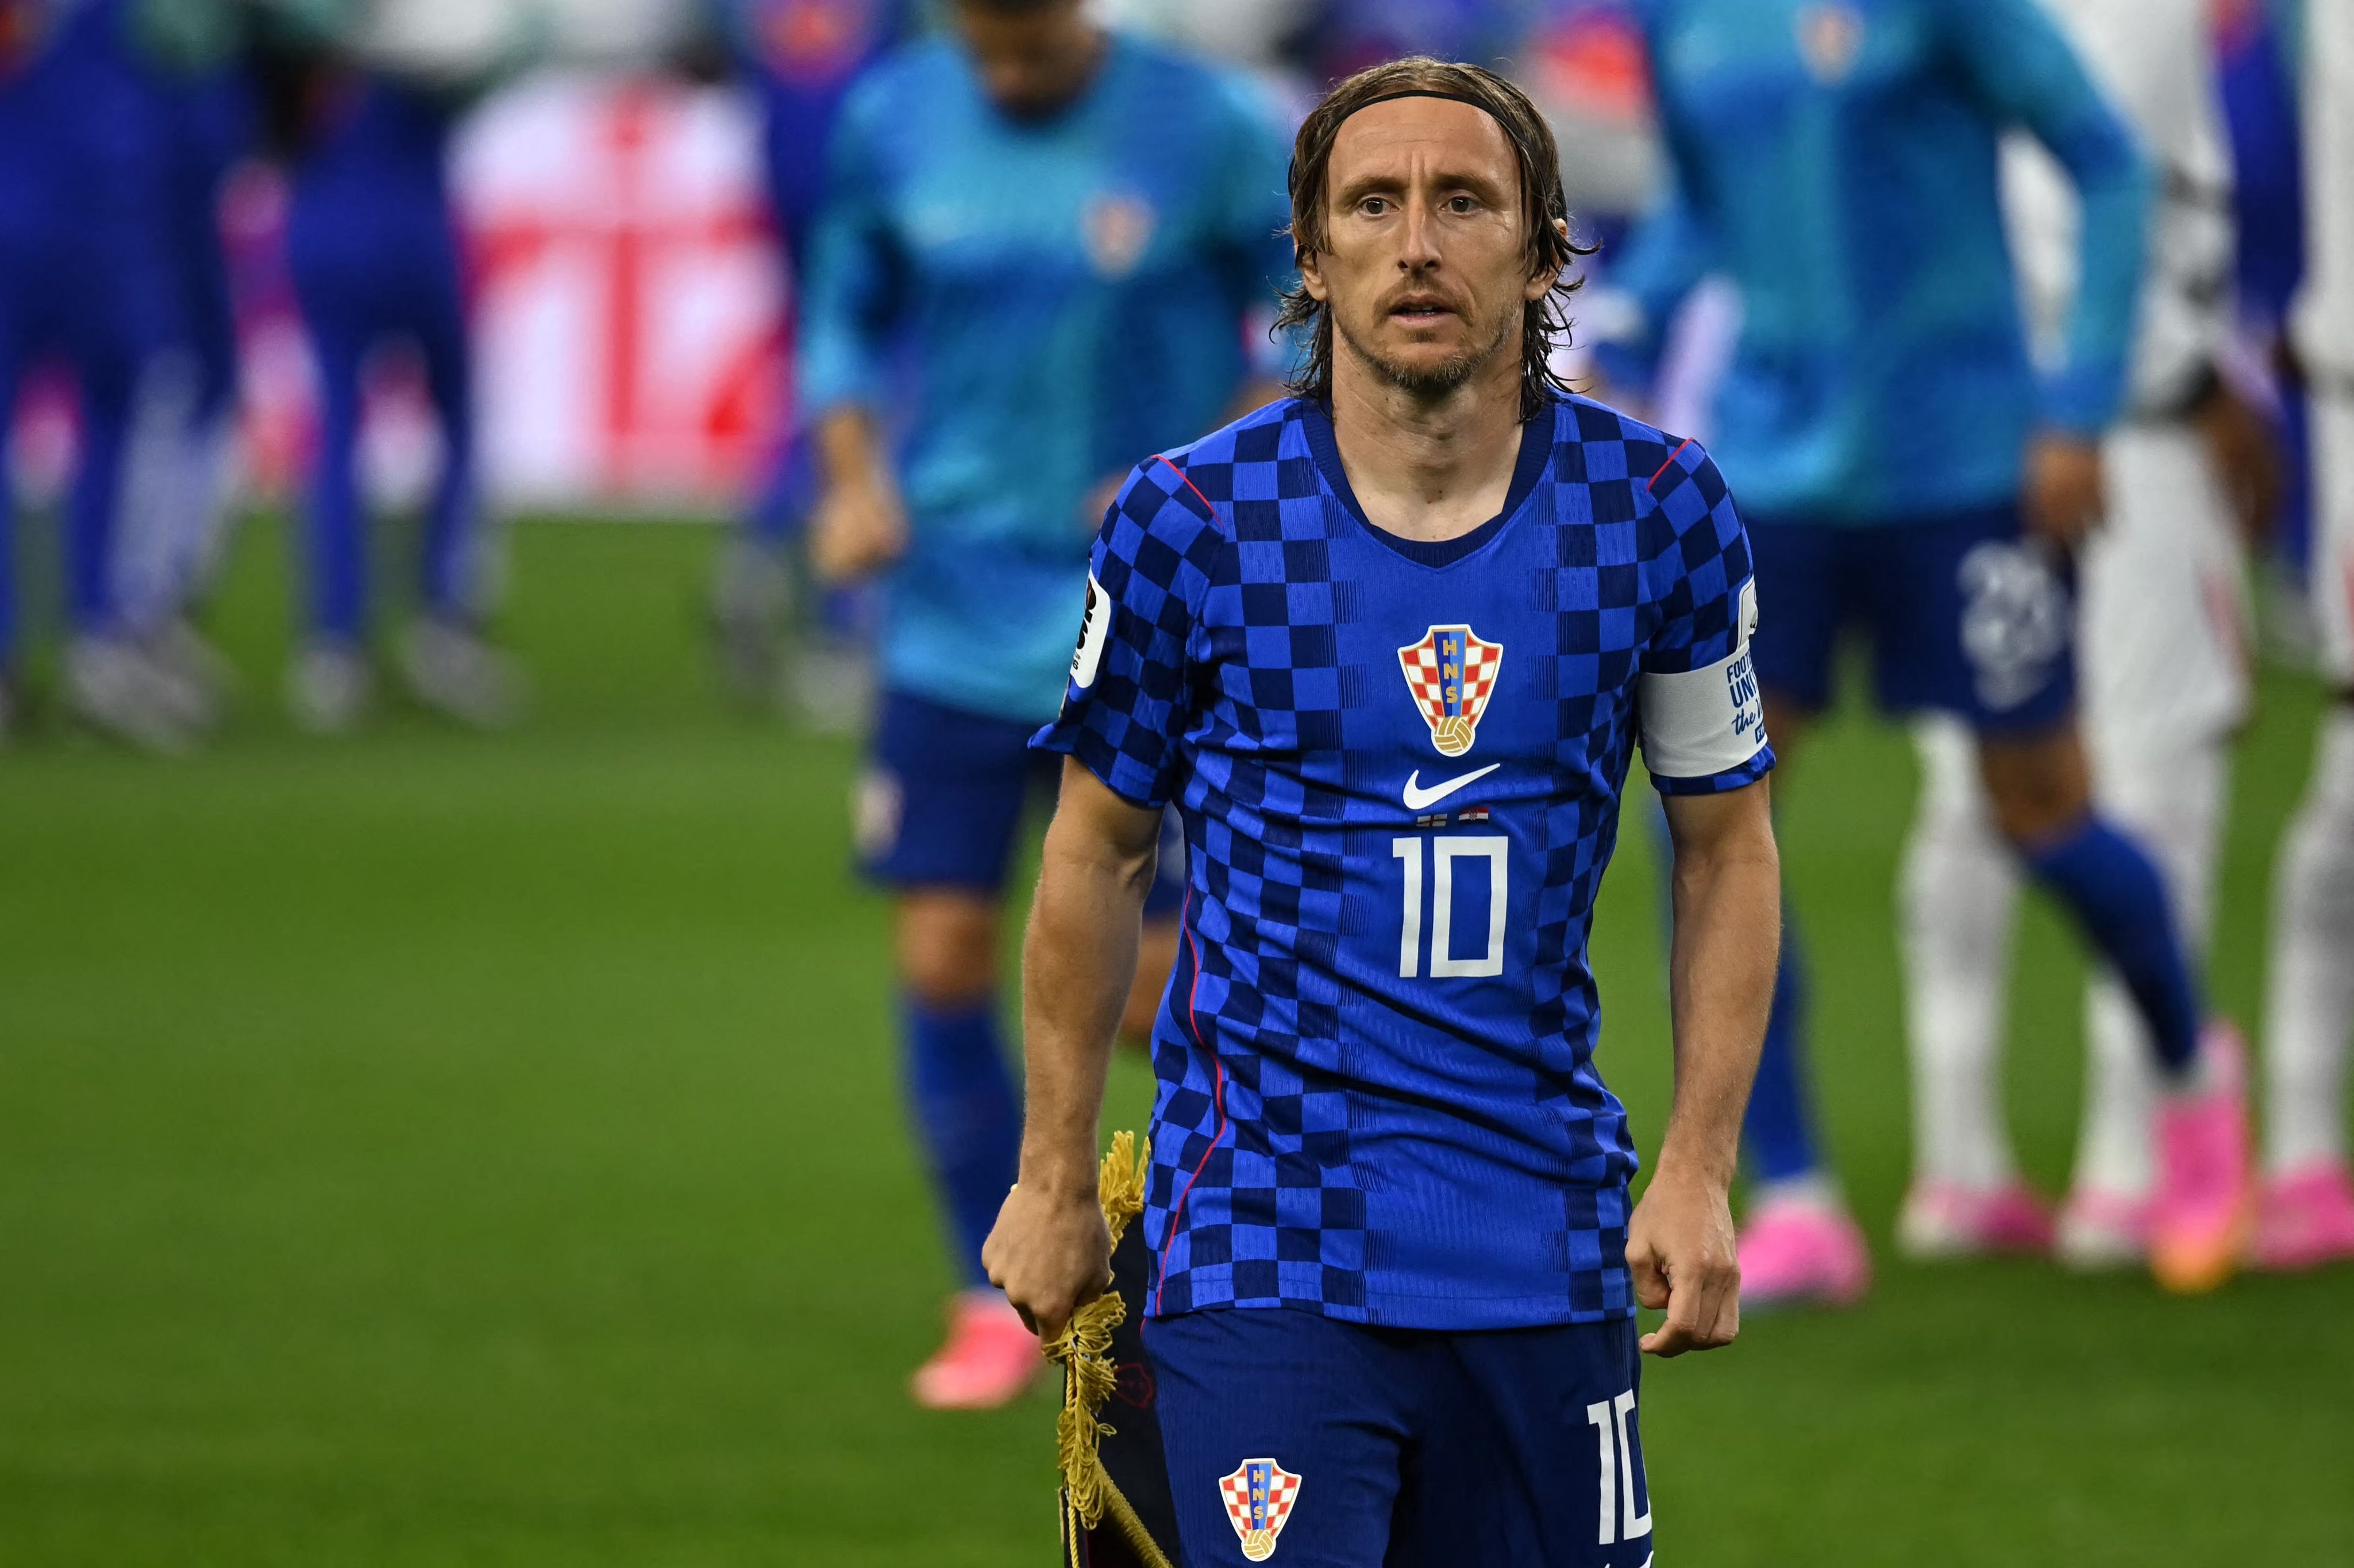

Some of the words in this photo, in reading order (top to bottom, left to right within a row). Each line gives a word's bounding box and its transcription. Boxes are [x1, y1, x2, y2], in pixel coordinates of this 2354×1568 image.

[1442, 639, 1458, 704] HNS
[1729, 668, 1758, 708] UNI
[1731, 708, 1756, 735] the
[1392, 836, 1508, 978] 10
[1253, 1469, 1265, 1520] HNS
[1586, 1388, 1652, 1544] 10
